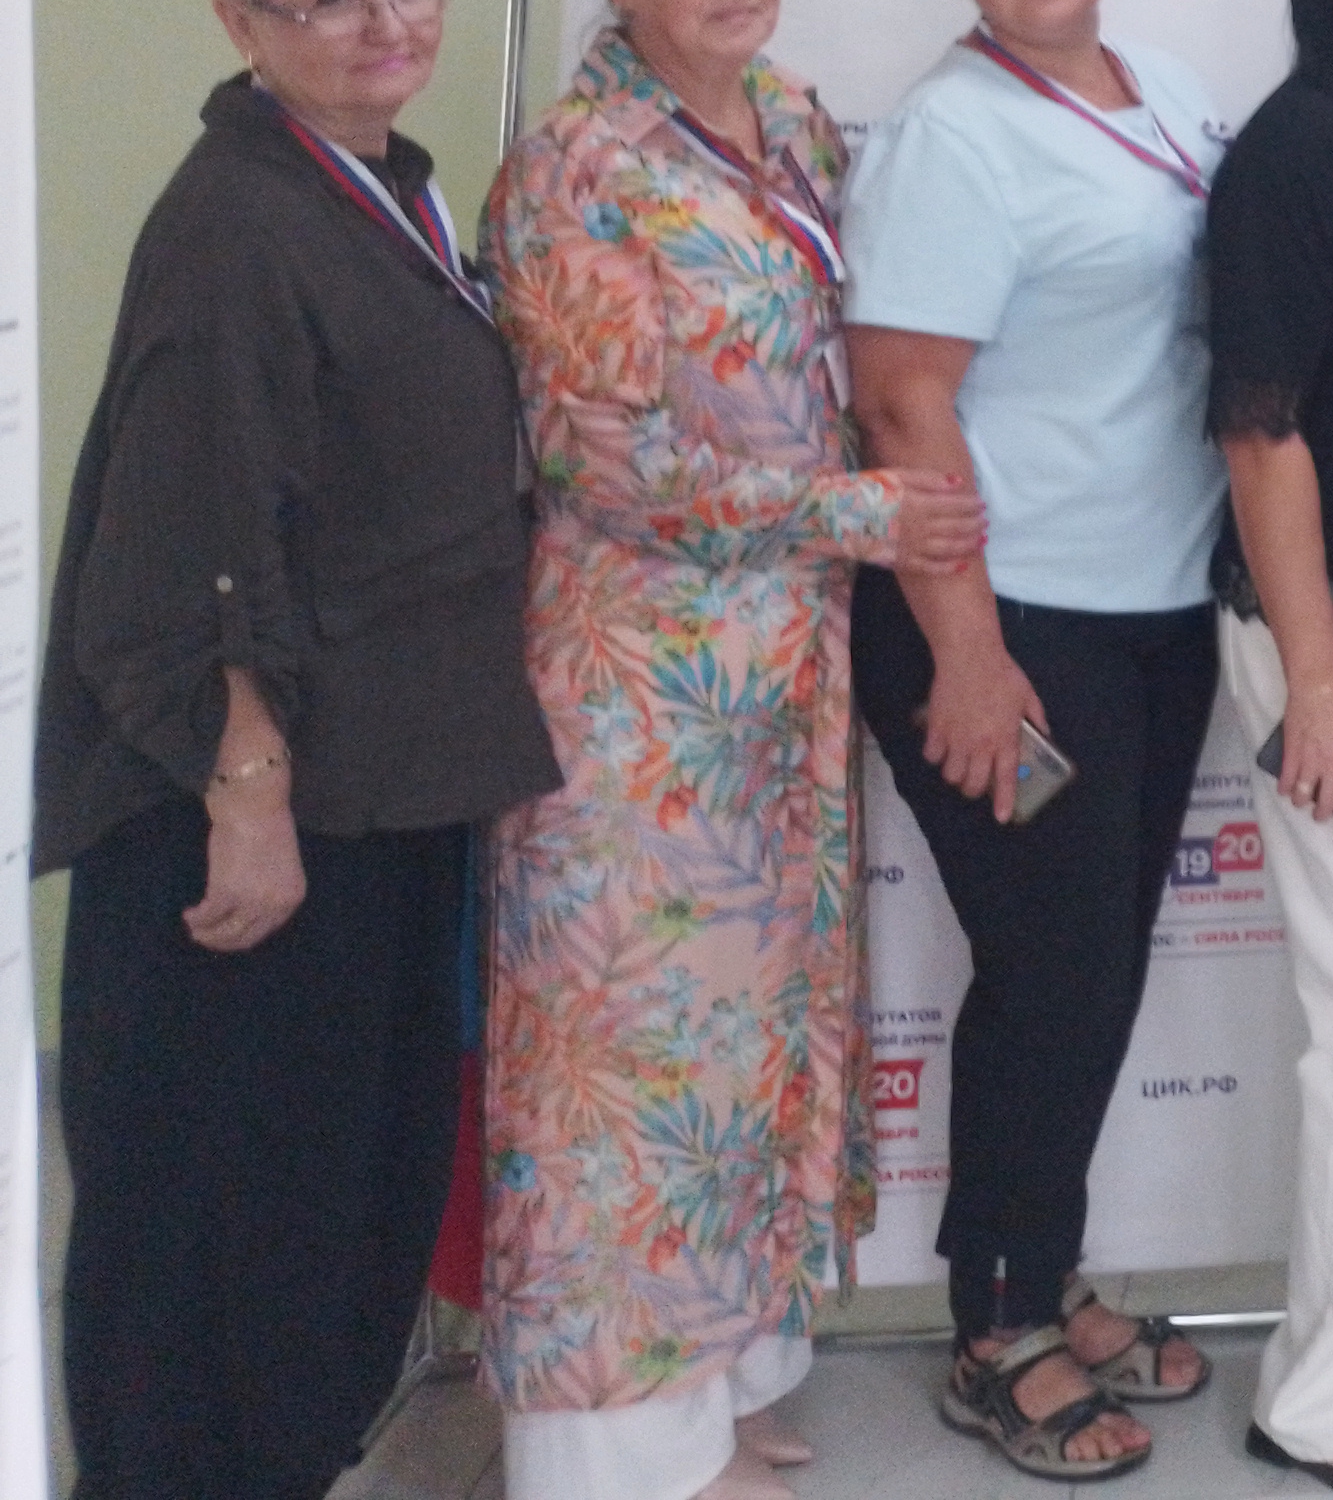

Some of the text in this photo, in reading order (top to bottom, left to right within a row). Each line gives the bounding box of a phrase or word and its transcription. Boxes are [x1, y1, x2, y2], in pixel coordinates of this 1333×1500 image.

[1176, 832, 1262, 878] 19 20
[874, 1069, 917, 1101] 20
[1142, 1074, 1238, 1099] ЦИК.РФ
